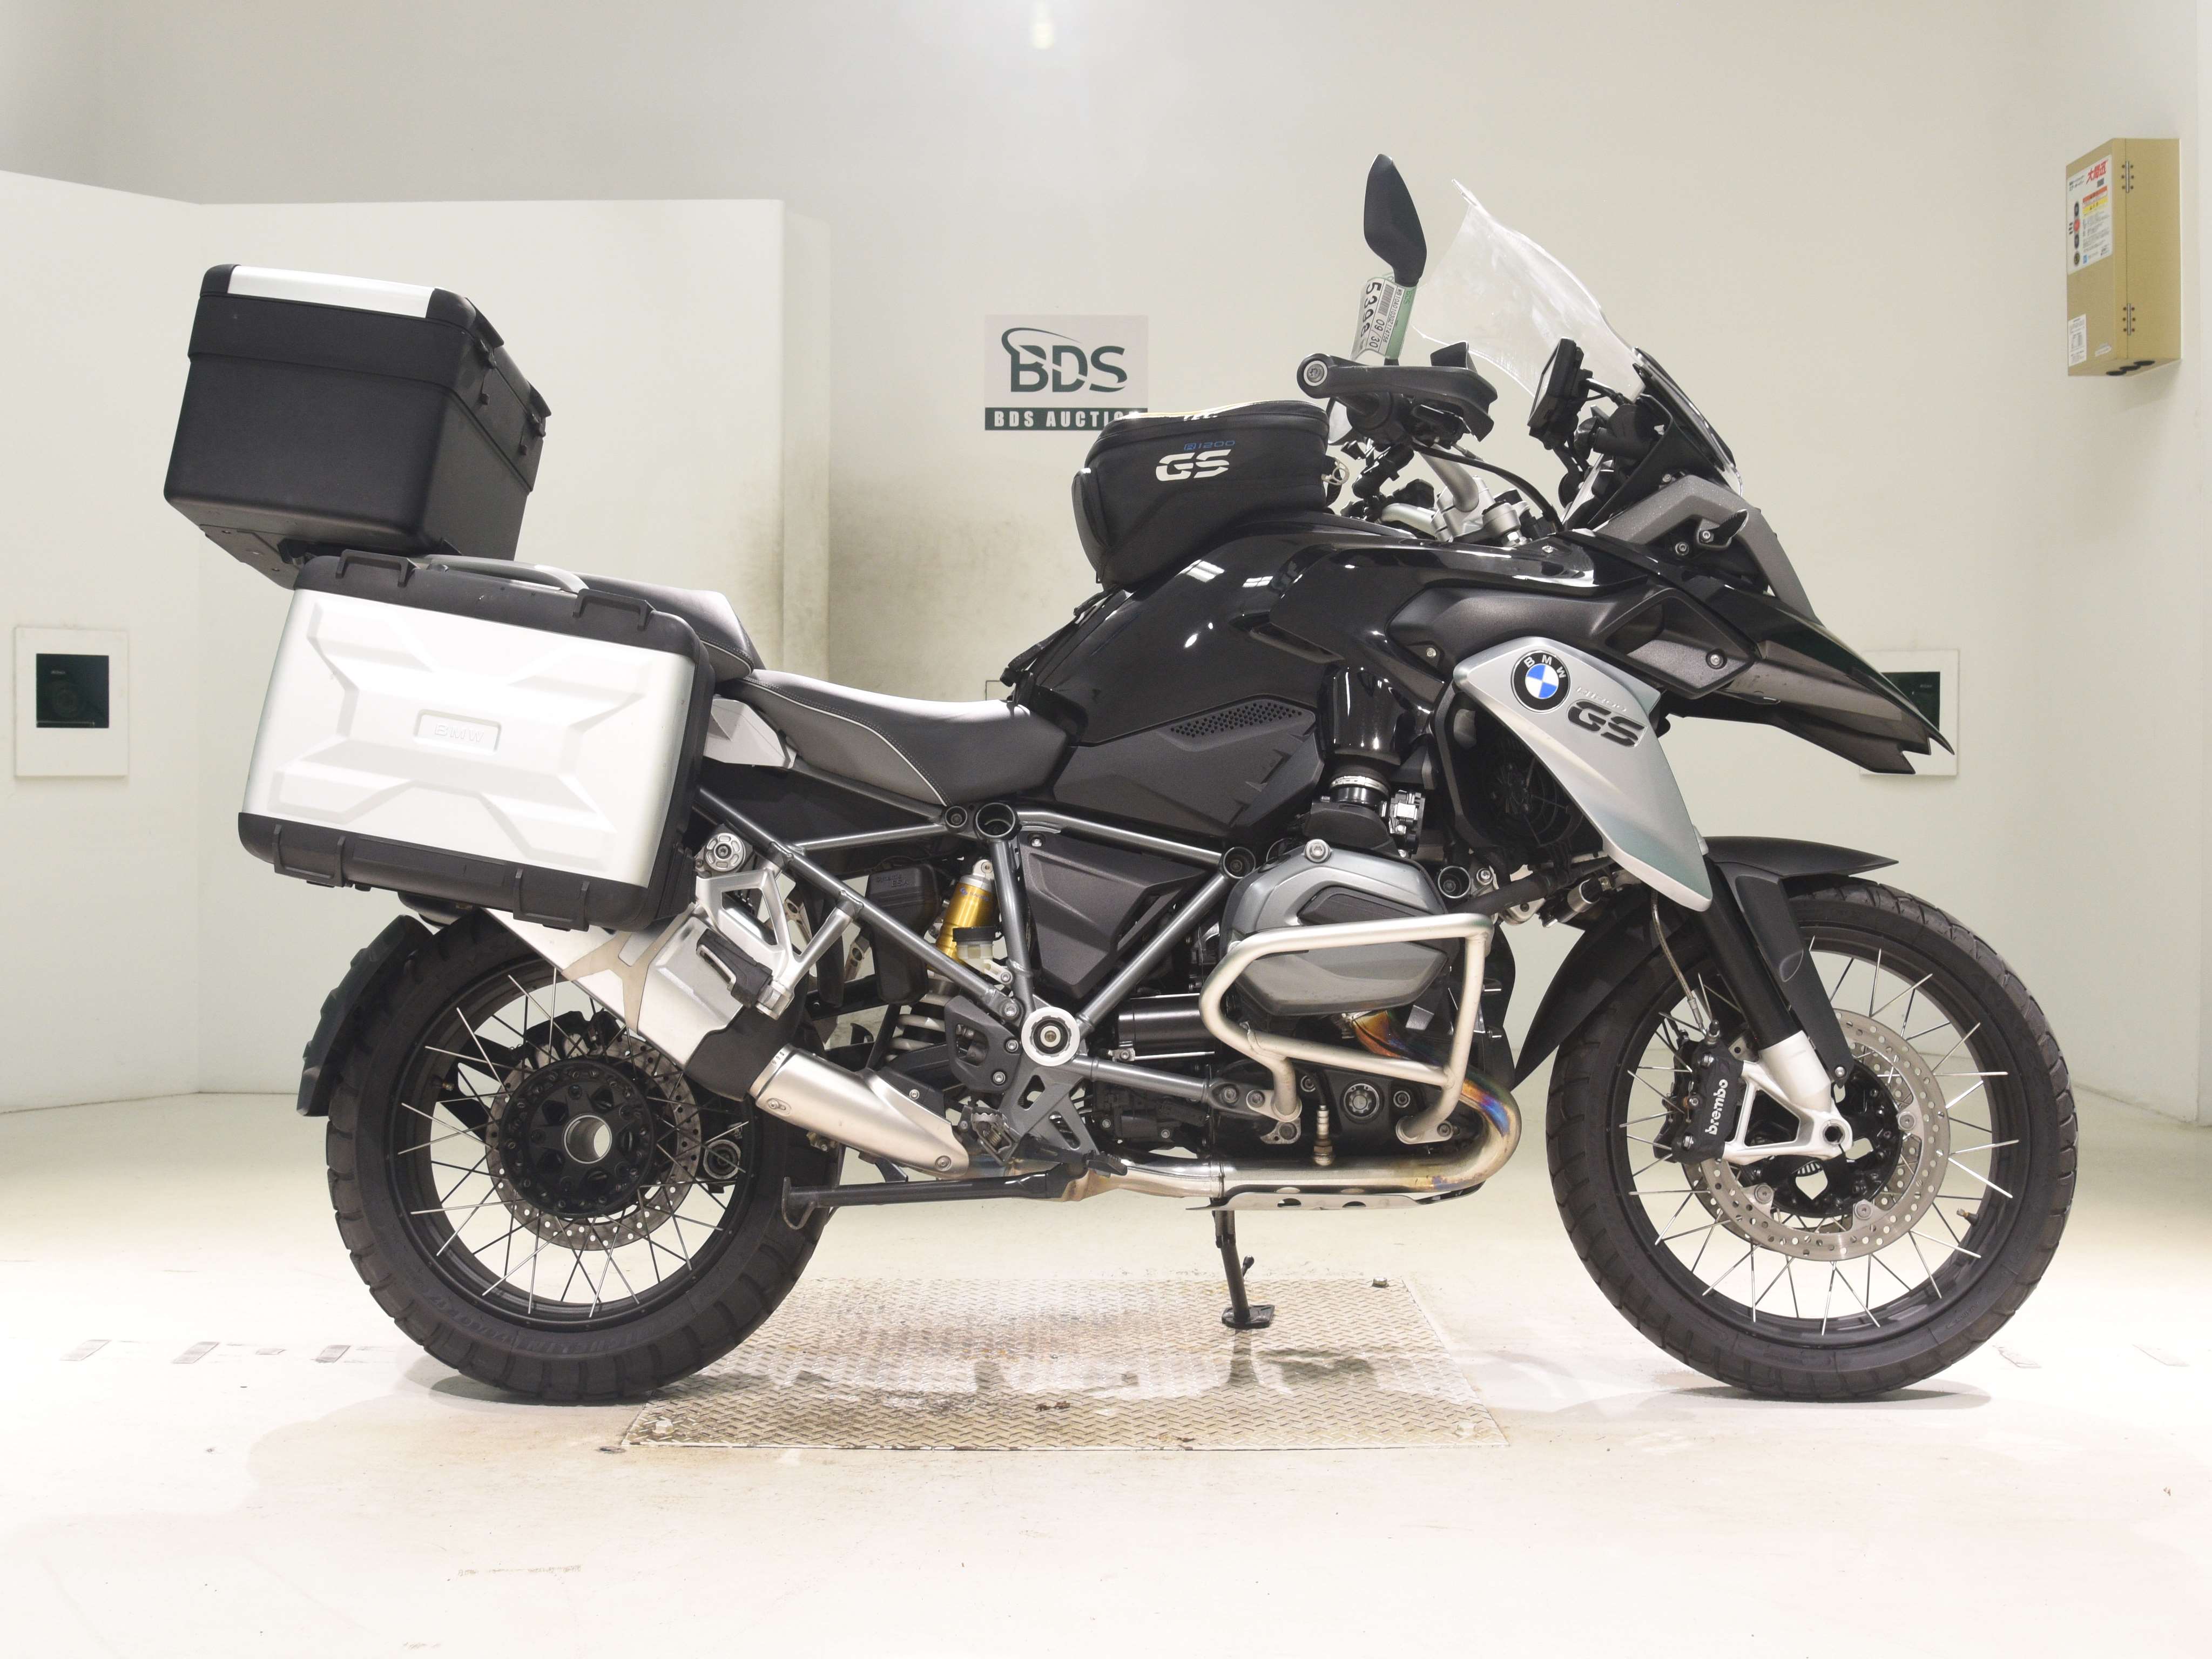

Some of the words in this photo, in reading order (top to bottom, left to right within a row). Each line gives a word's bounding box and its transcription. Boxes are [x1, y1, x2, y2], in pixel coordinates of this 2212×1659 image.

[1360, 282, 1382, 338] 5398
[1369, 319, 1385, 348] 09/30
[1002, 327, 1128, 393] BDS
[994, 410, 1034, 427] BDS
[1046, 410, 1124, 427] AUCTI
[1156, 449, 1232, 482] GS
[1523, 654, 1567, 678] BMW
[434, 723, 484, 743] BMW
[1567, 701, 1645, 747] GS
[1704, 1079, 1728, 1136] brembo
